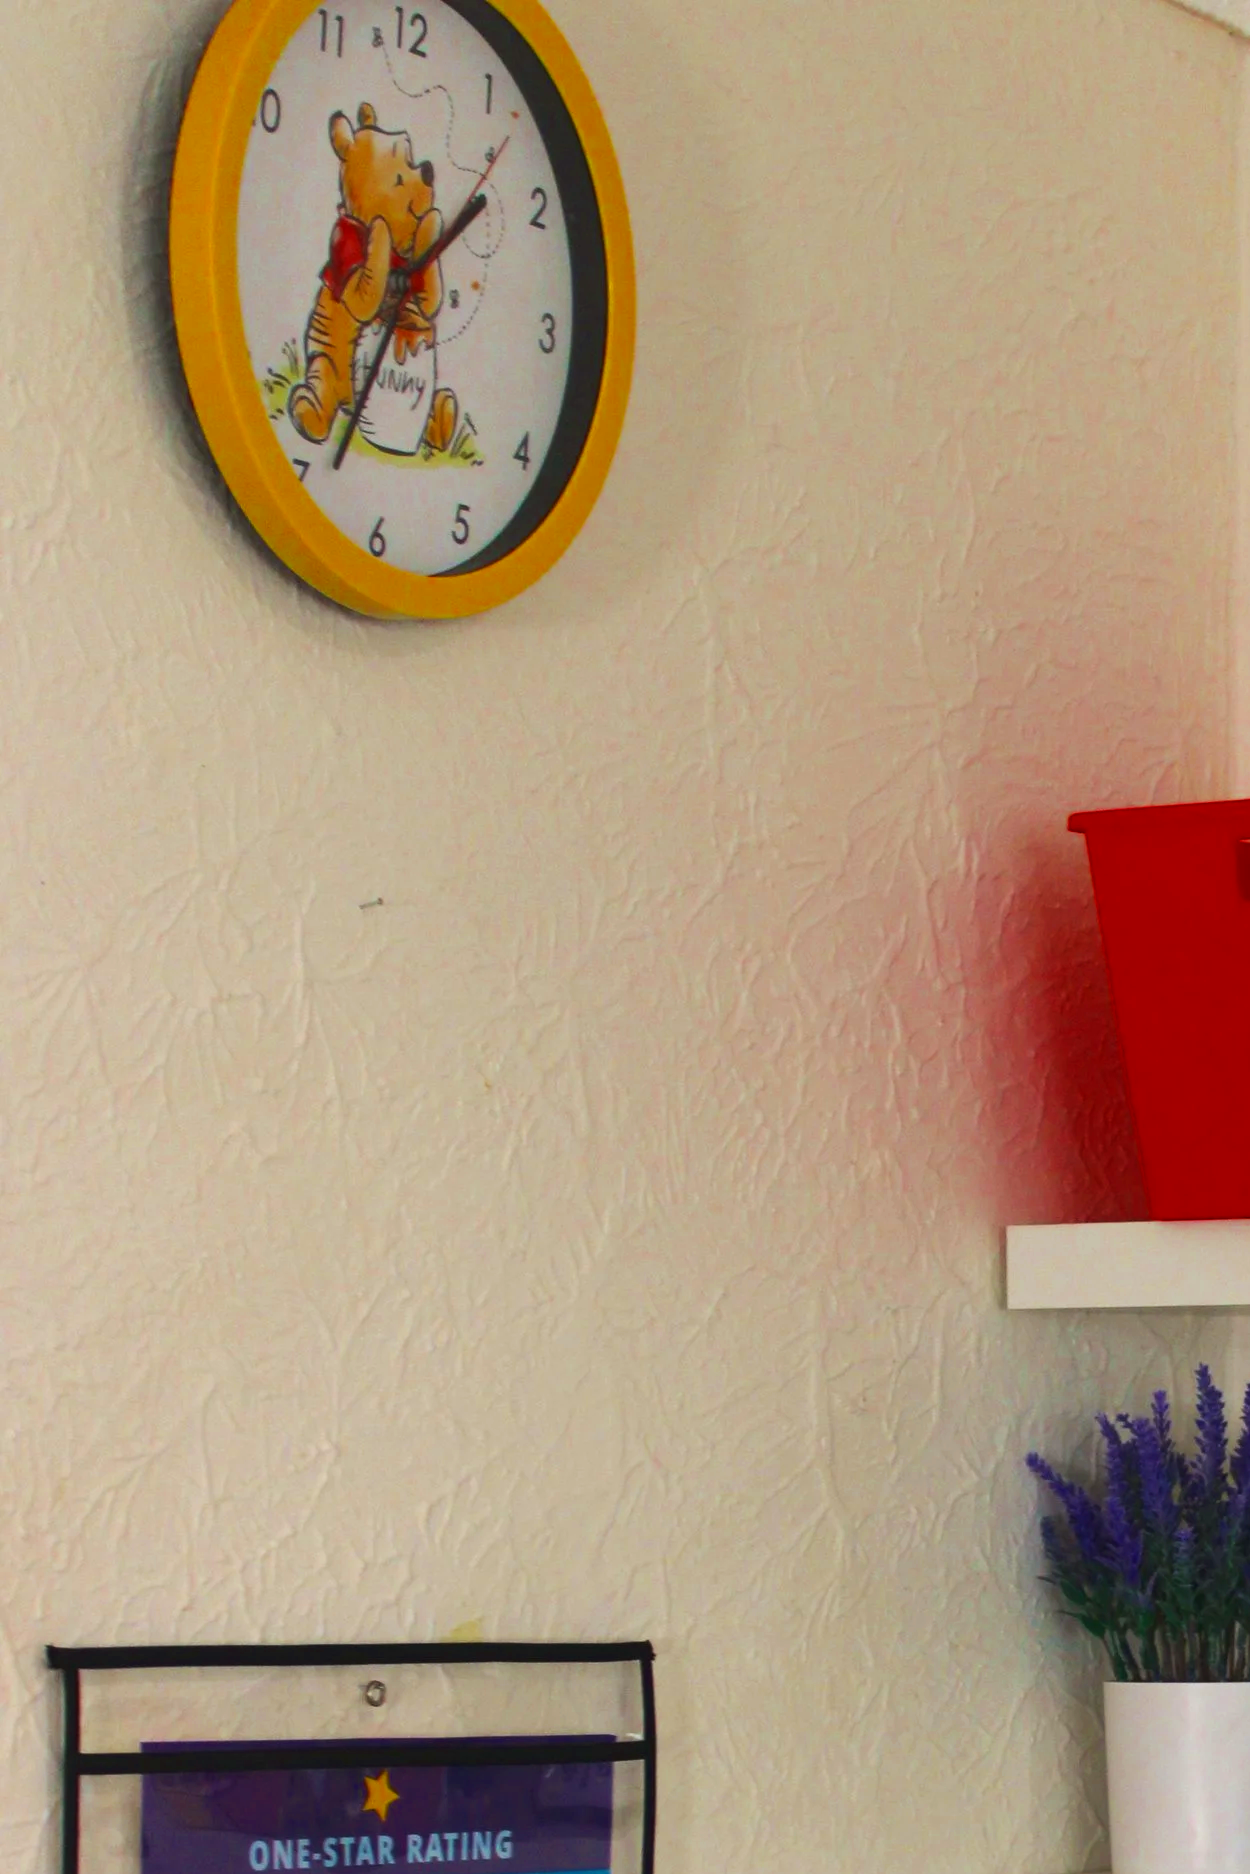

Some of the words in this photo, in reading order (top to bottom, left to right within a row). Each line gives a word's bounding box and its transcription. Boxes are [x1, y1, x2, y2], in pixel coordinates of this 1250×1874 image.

[317, 9, 343, 58] 11
[396, 6, 428, 58] 12
[254, 89, 282, 134] 0
[484, 73, 494, 114] 1
[530, 187, 548, 230] 2
[538, 313, 557, 354] 3
[293, 458, 310, 483] 7
[513, 432, 531, 471] 4
[369, 517, 386, 557] 6
[451, 504, 470, 545] 5
[249, 1835, 396, 1871] ONE-STAR
[407, 1830, 513, 1863] RATING
